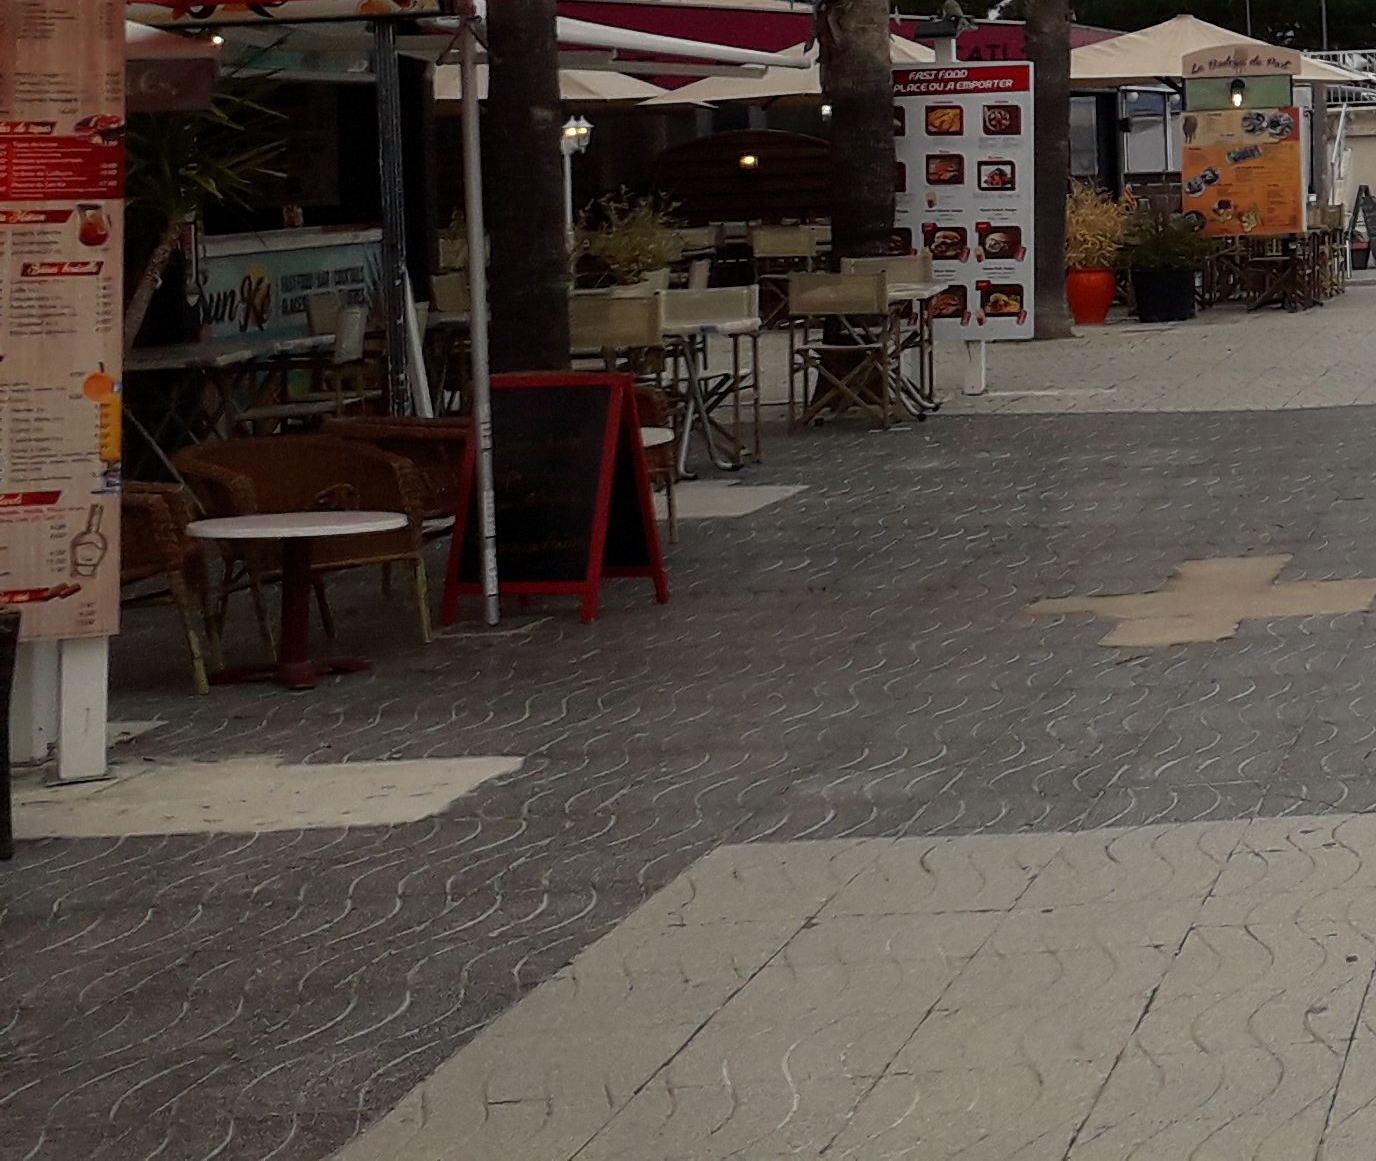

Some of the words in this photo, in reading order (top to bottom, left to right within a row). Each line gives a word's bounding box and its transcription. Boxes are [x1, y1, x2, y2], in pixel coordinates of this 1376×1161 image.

[908, 69, 938, 81] FAST
[938, 69, 969, 80] FOOD
[893, 82, 928, 93] PLACE
[928, 82, 944, 91] OU
[956, 78, 1014, 90] EMPORTER
